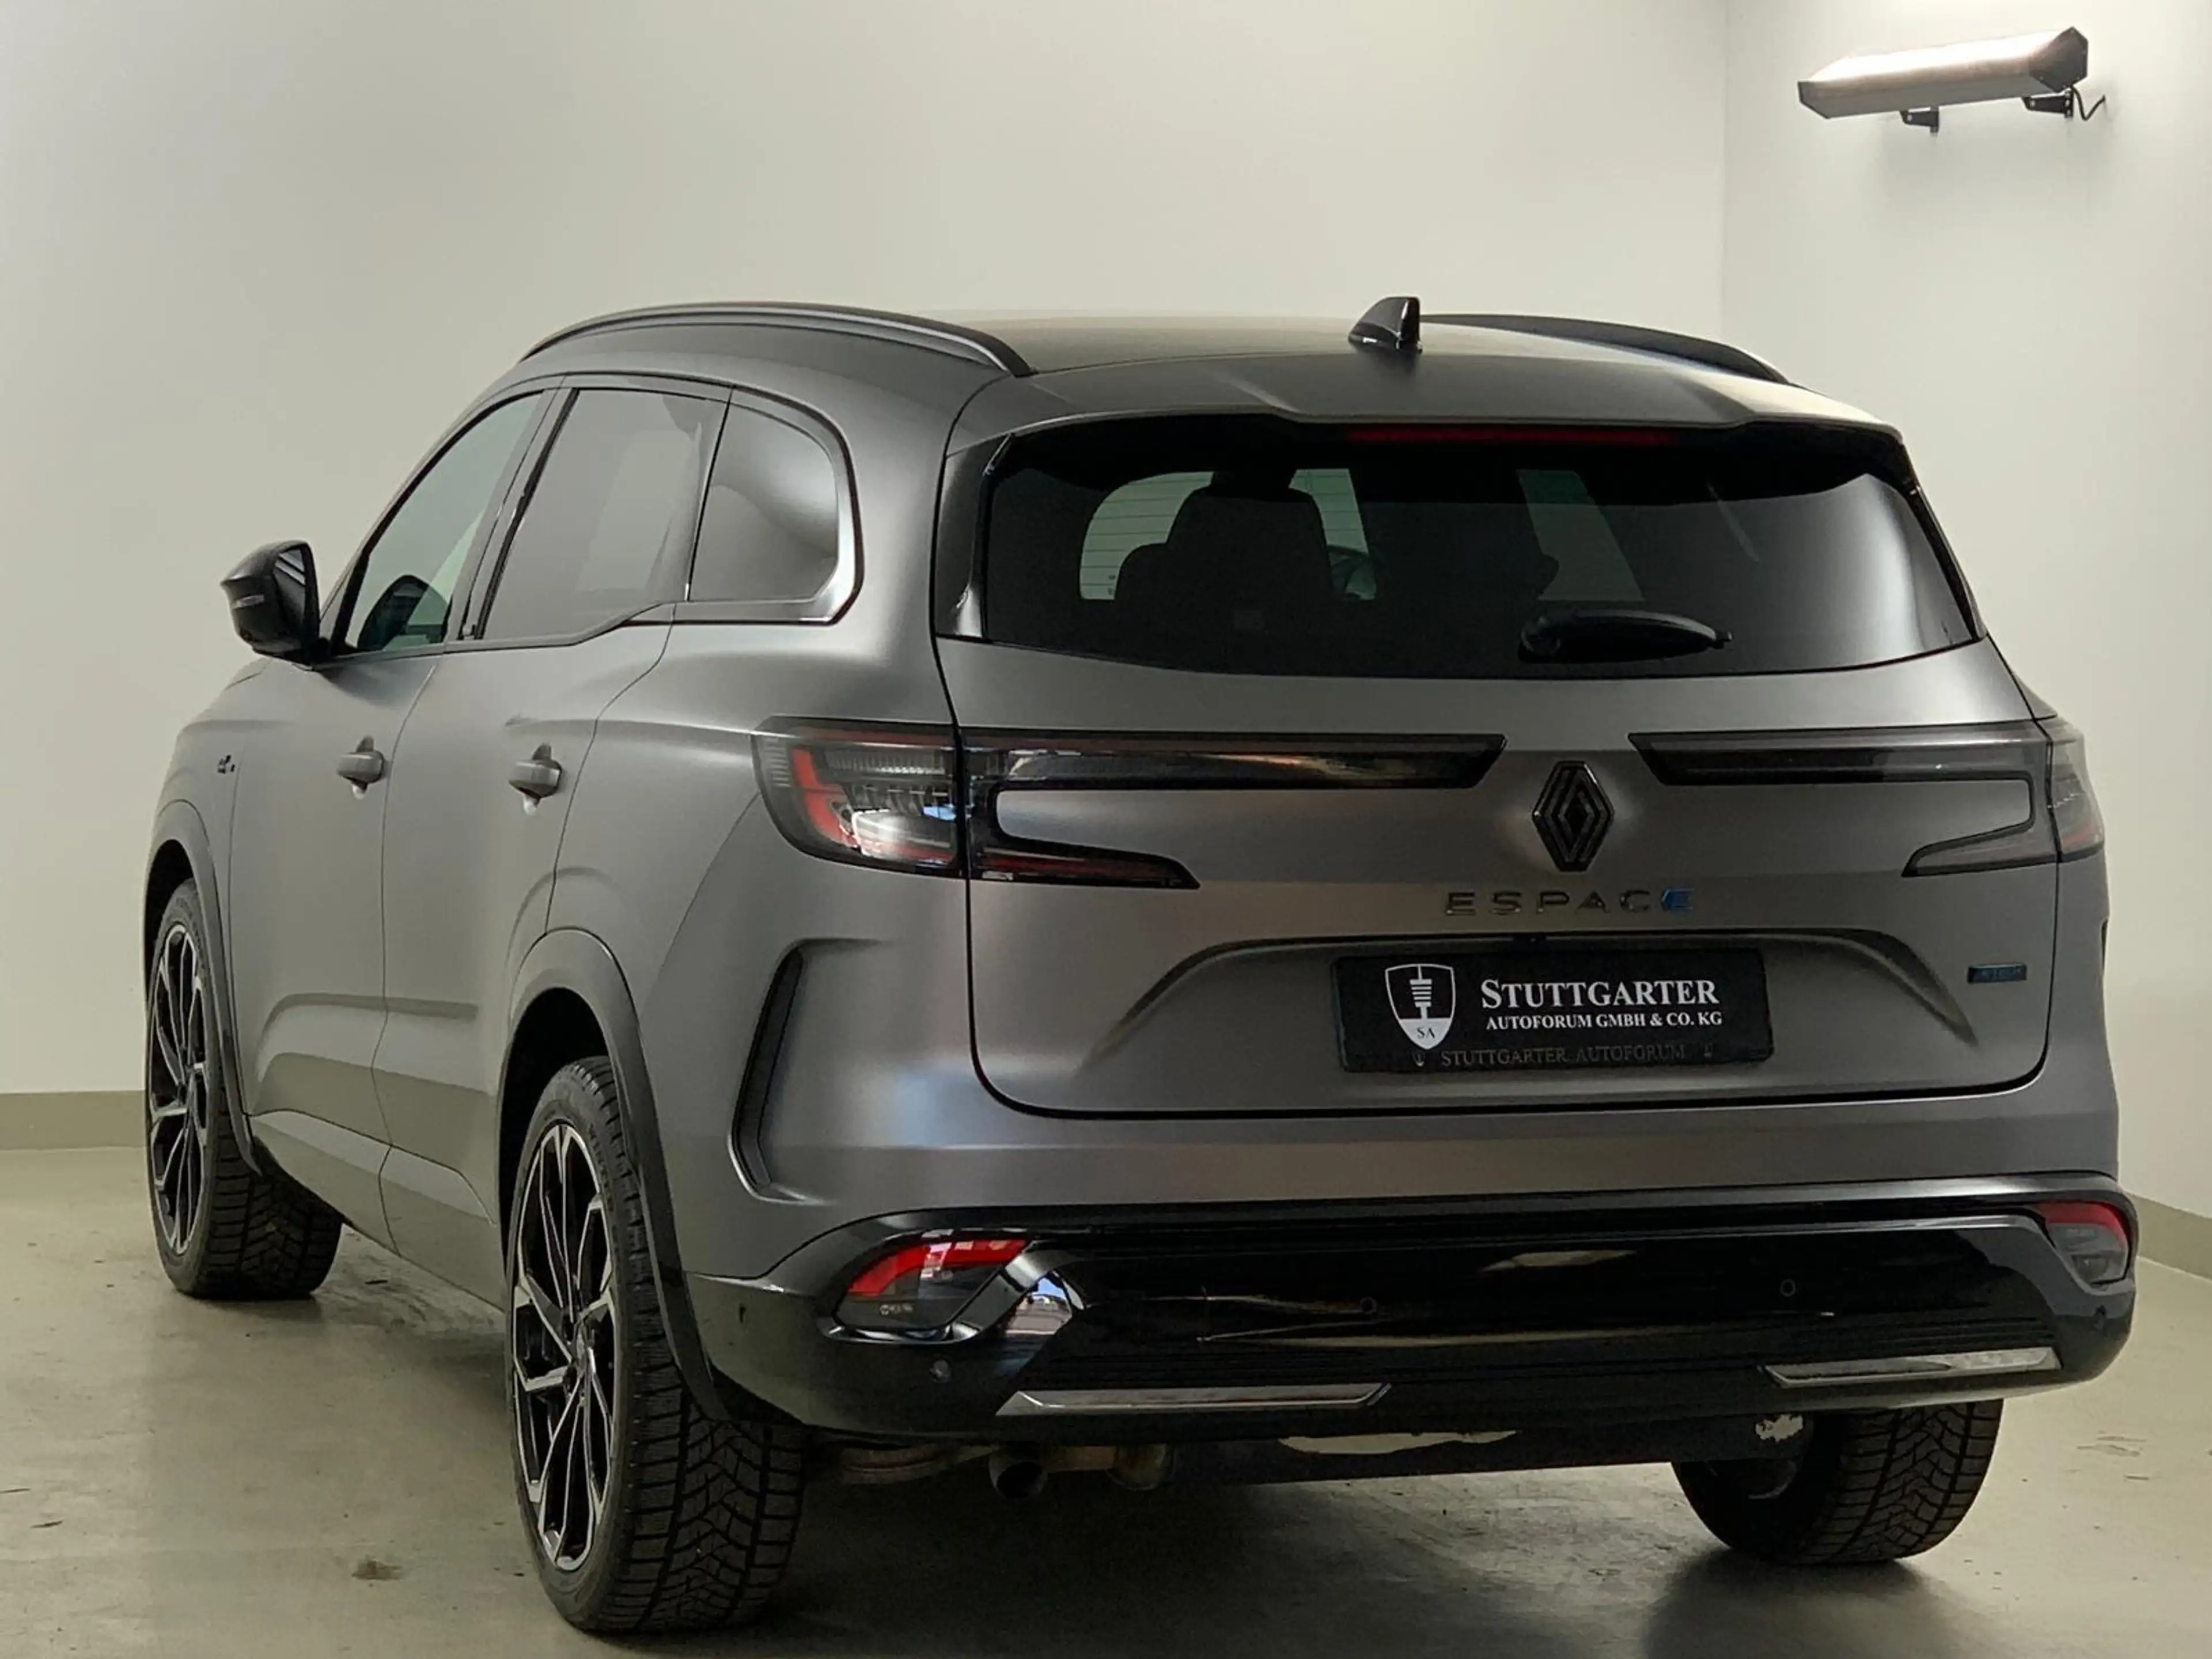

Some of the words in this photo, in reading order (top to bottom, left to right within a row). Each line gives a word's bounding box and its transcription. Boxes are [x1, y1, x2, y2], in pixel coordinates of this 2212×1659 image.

[1444, 888, 1694, 916] ESPACE
[1486, 1014, 1592, 1030] AUTOFORUM
[1596, 1012, 1646, 1028] GMBH
[1650, 1012, 1663, 1027] &
[1666, 1012, 1695, 1027] CO.
[1698, 1011, 1722, 1026] KG
[1441, 1047, 1568, 1067] STUTTGARTER
[1575, 1043, 1687, 1062] AUTOFORUM
